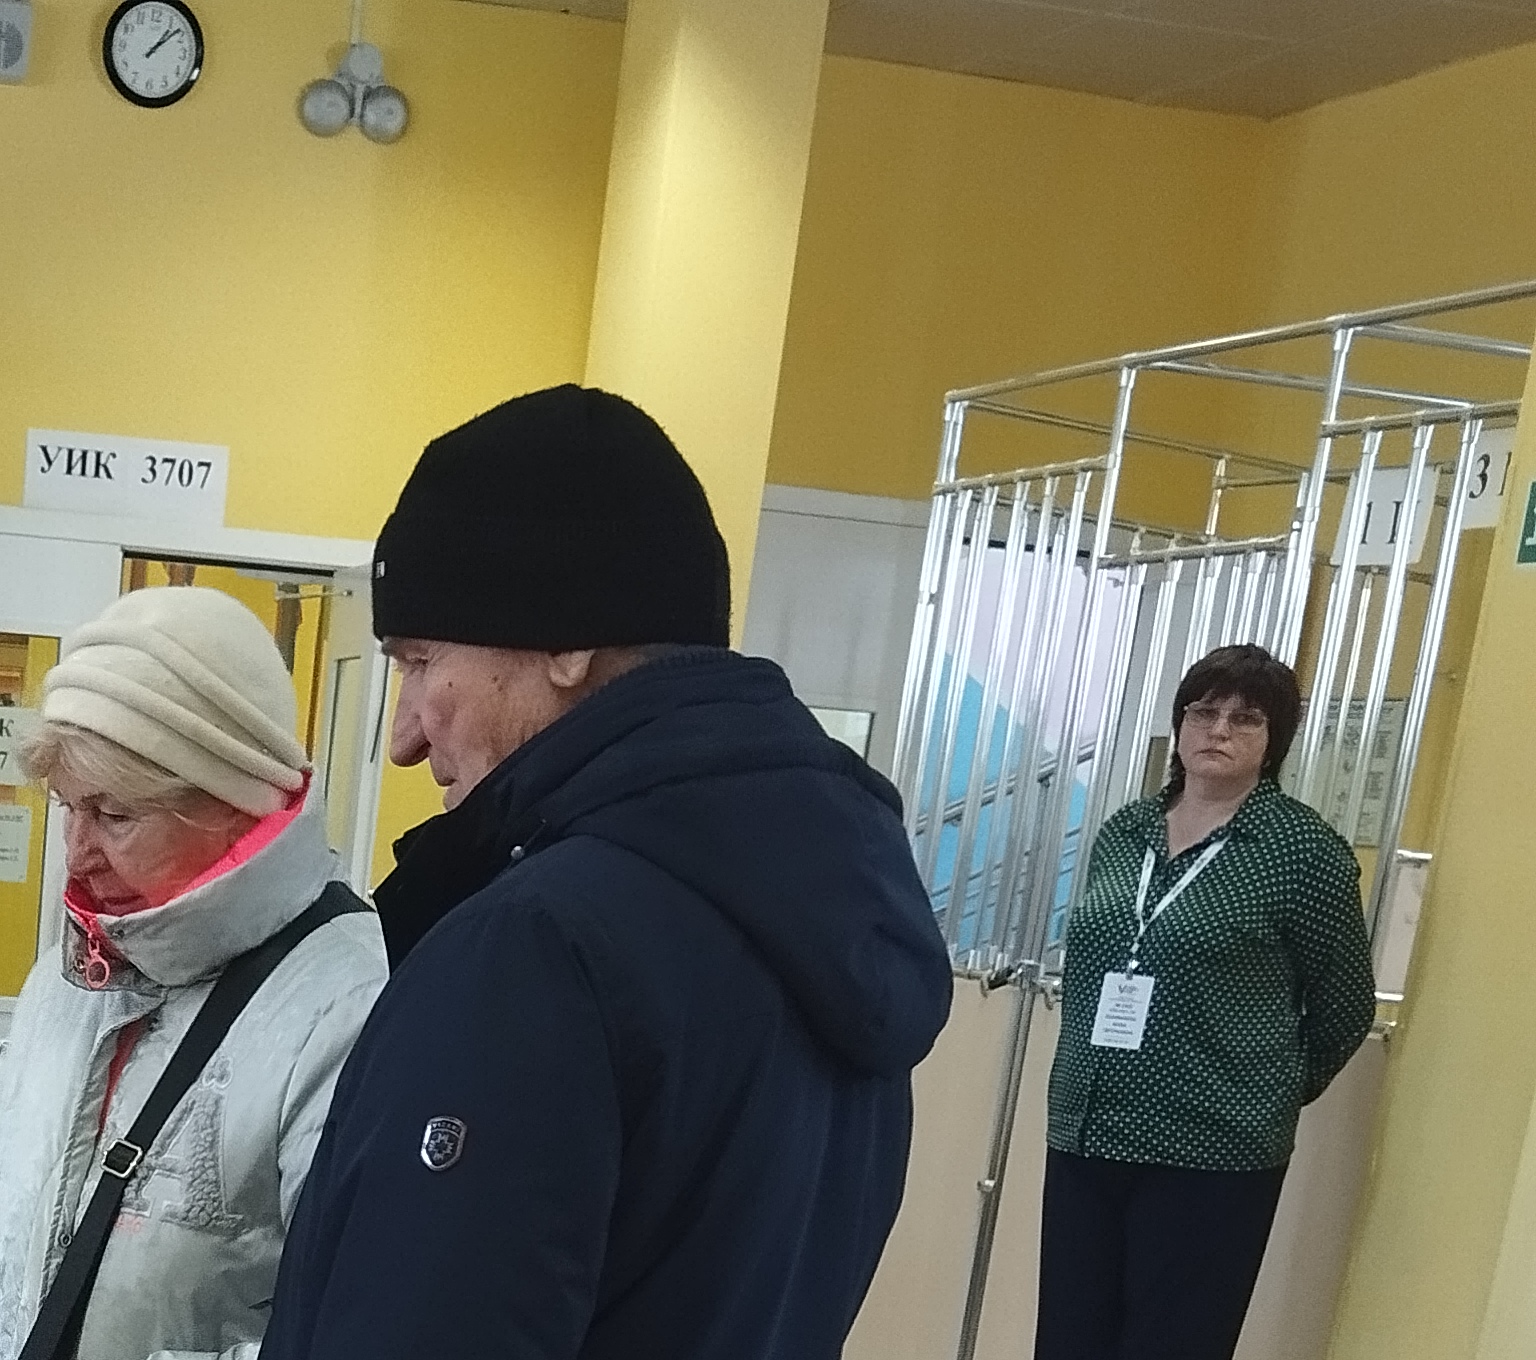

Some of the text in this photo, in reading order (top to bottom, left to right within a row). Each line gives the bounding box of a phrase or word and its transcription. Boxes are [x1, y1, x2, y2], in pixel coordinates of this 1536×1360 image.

[38, 443, 213, 490] УИК 3707
[1469, 453, 1491, 499] 3
